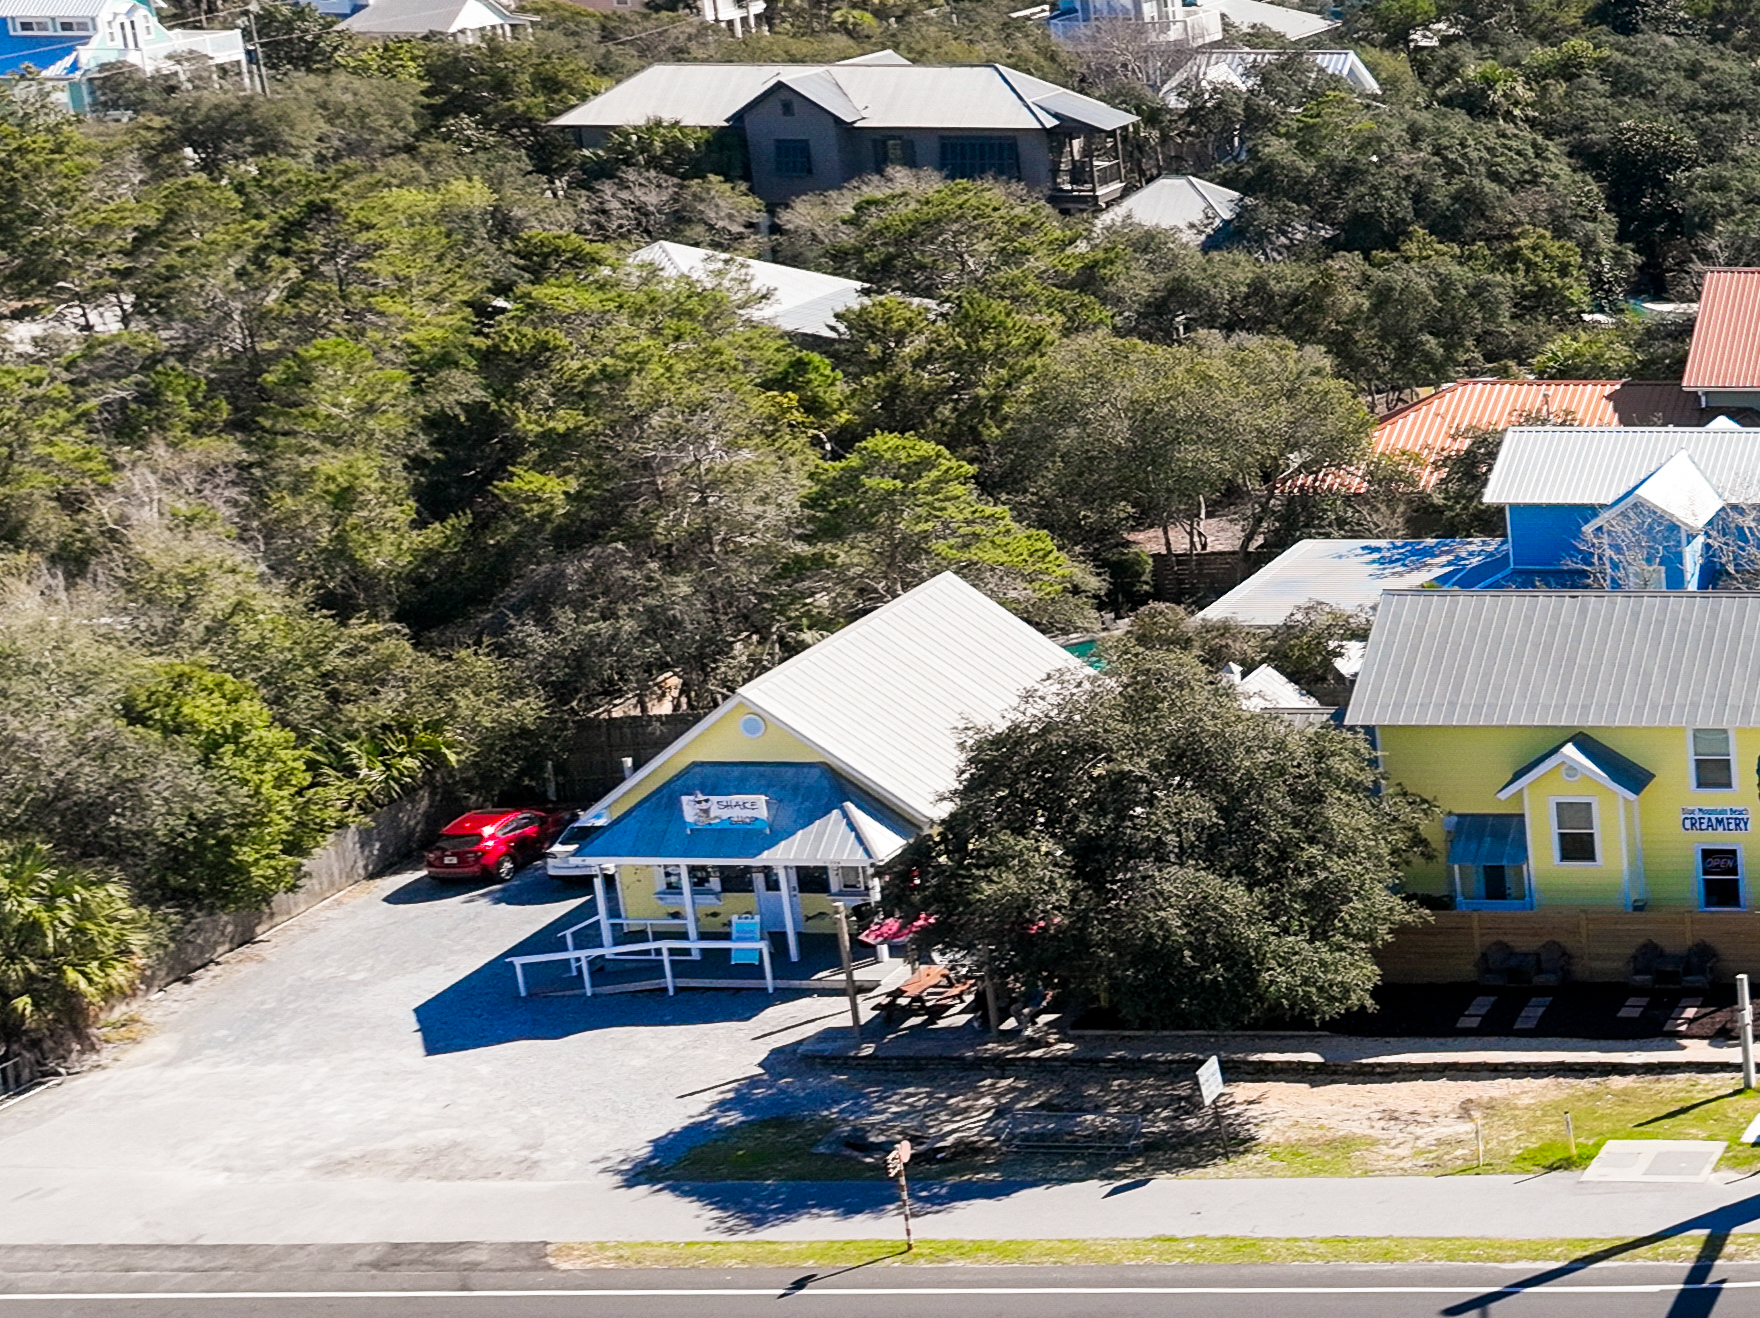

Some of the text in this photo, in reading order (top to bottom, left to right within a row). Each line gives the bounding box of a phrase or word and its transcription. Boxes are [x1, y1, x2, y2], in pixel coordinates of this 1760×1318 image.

[716, 800, 758, 810] SHAKE
[727, 816, 758, 826] SHOP
[1682, 817, 1750, 831] CREAMERY
[1705, 857, 1733, 868] OPEN
